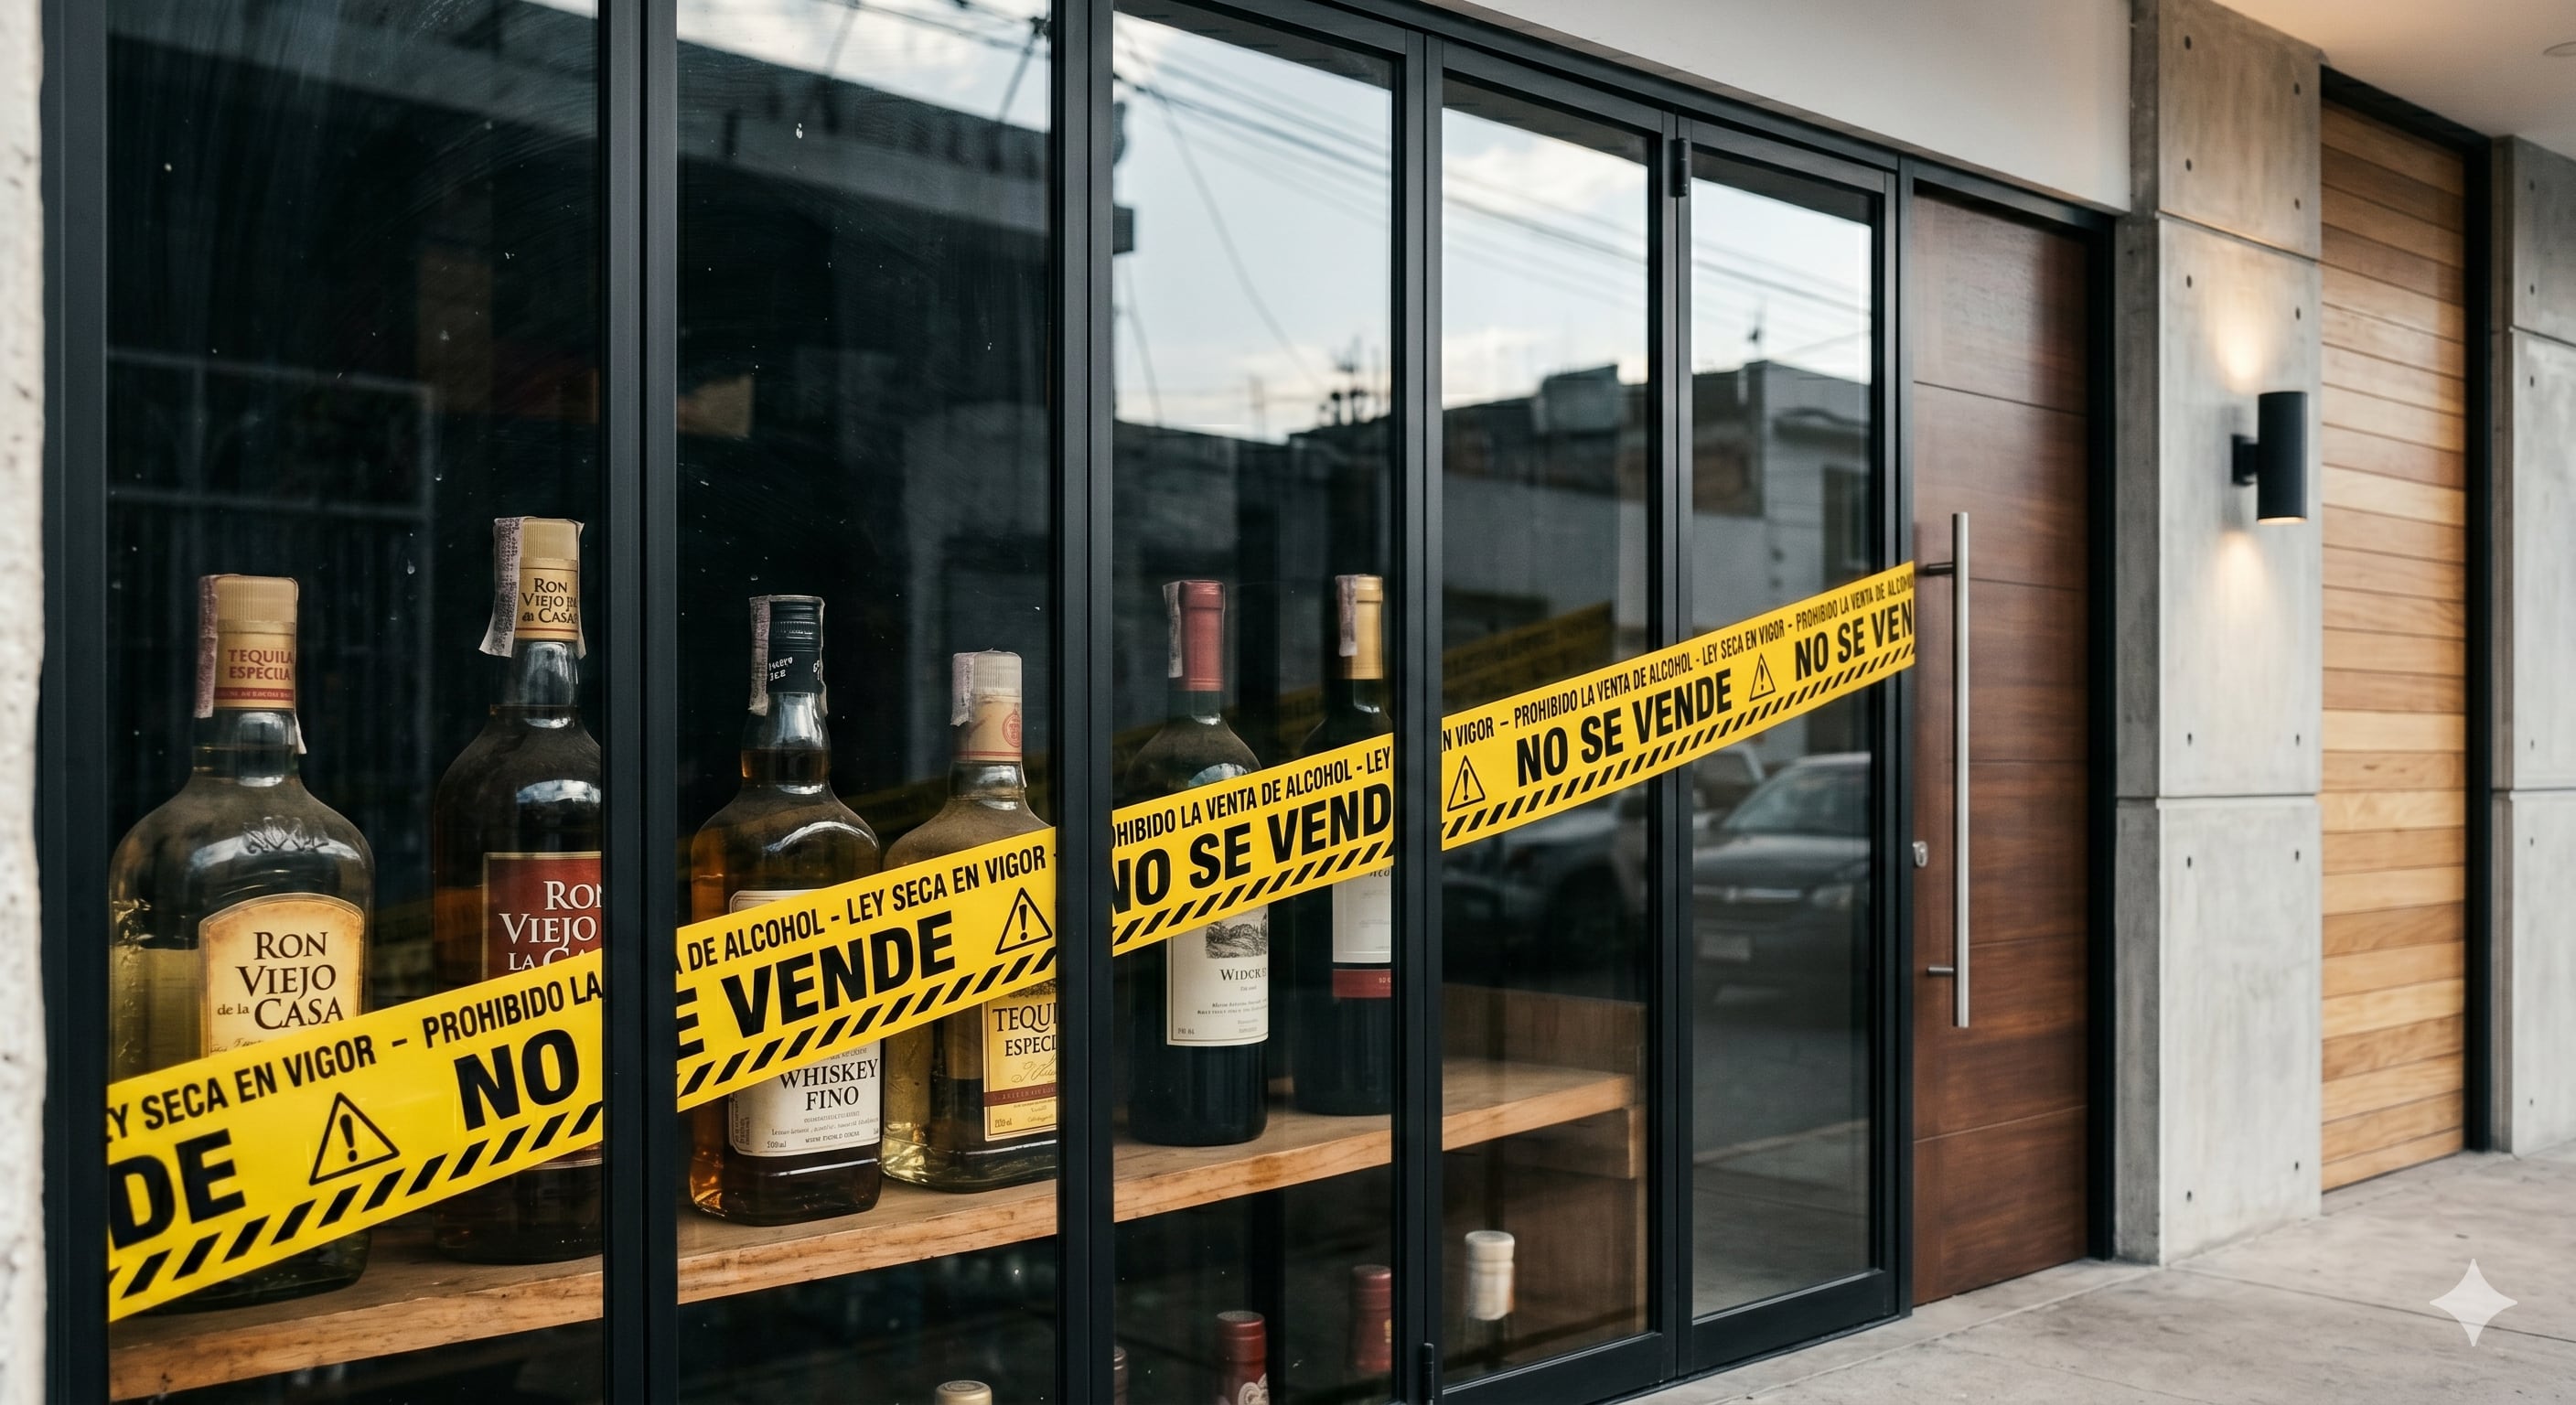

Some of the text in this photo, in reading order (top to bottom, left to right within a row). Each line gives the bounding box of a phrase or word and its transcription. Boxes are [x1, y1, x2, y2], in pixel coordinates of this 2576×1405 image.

[228, 649, 293, 666] TEQUILA
[1442, 729, 1453, 753] N
[1455, 717, 1494, 747] VIGOR
[1514, 690, 1578, 728] PROHIBIDO
[1581, 684, 1594, 708] LA
[1596, 673, 1631, 702] VENTA
[1633, 667, 1647, 691] DE
[1649, 652, 1693, 685] ALCOHOL
[1702, 642, 1718, 666] LEY
[1721, 635, 1744, 660] SECA
[1745, 629, 1757, 650] EN
[1758, 618, 1785, 646] VIGOR
[1796, 599, 1838, 632] PROHIBIDO
[1840, 597, 1850, 615] LA
[1851, 587, 1873, 610] VENTA
[1875, 583, 1885, 602] DE
[1517, 598, 1913, 788] NO SE VENDE NO SE VEN
[1180, 801, 1202, 829] LA
[1206, 787, 1257, 820] VENTA
[1261, 778, 1281, 806] DE
[1286, 758, 1352, 799] ALCOHOL
[1366, 745, 1390, 775] LEY
[1112, 783, 1392, 915] NO SE VEND
[499, 913, 596, 949] VIEJO
[687, 936, 718, 971] DE
[724, 908, 825, 961] ALCOHOL
[846, 889, 885, 925] LEY
[892, 874, 948, 911] SECA
[952, 863, 980, 894] EN
[984, 844, 1046, 884] VIGOR
[253, 931, 328, 960] RON
[508, 952, 535, 971] LA
[720, 910, 955, 1038] VENDE
[235, 964, 336, 1000] VIEJO
[217, 997, 344, 1030] de la CASA
[141, 1078, 229, 1131] SECA
[234, 1062, 278, 1103] EN
[283, 1035, 377, 1088] VIGOR
[422, 981, 565, 1049] PROHIBIDO
[570, 971, 604, 1005] LA
[779, 1058, 879, 1089] WHISKEY
[805, 1086, 859, 1111] FINO
[108, 1029, 580, 1250] DE NO
